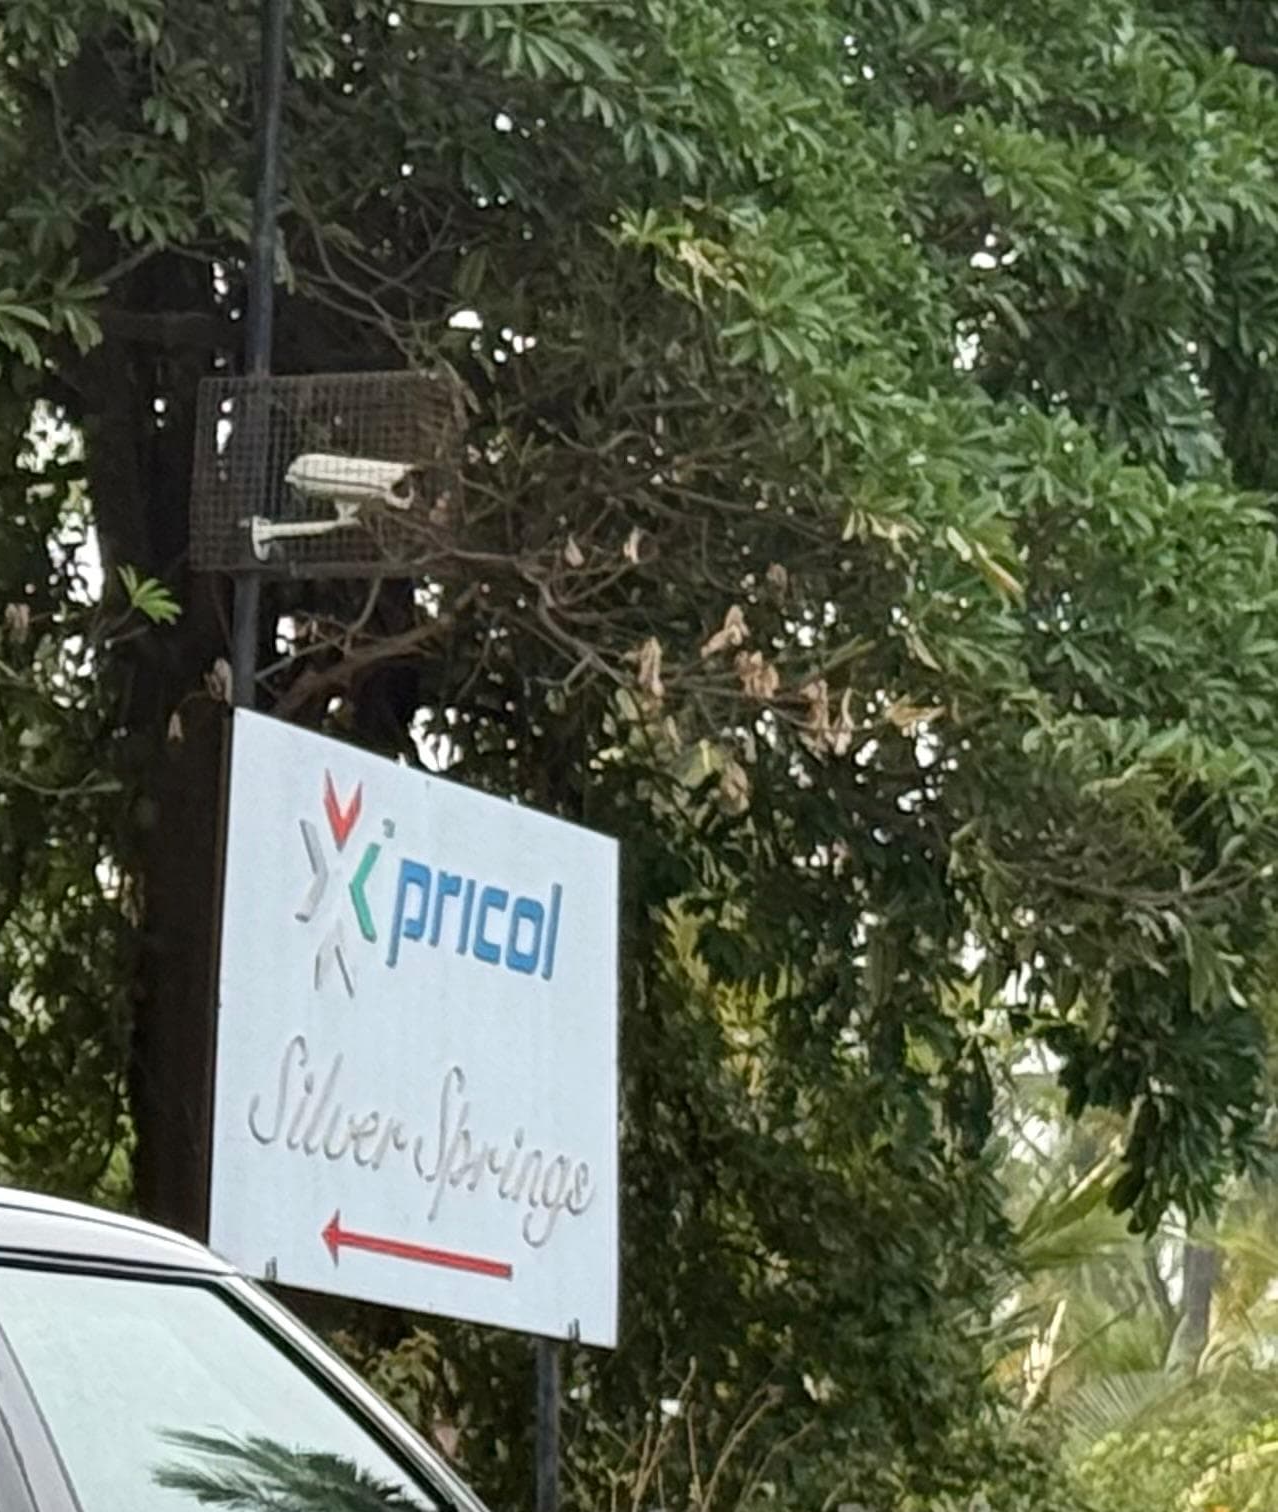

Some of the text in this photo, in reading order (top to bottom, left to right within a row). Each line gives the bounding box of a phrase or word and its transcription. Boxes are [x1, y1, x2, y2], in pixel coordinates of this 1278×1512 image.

[386, 859, 564, 981] pricol
[249, 1035, 596, 1249] Silver Springs
